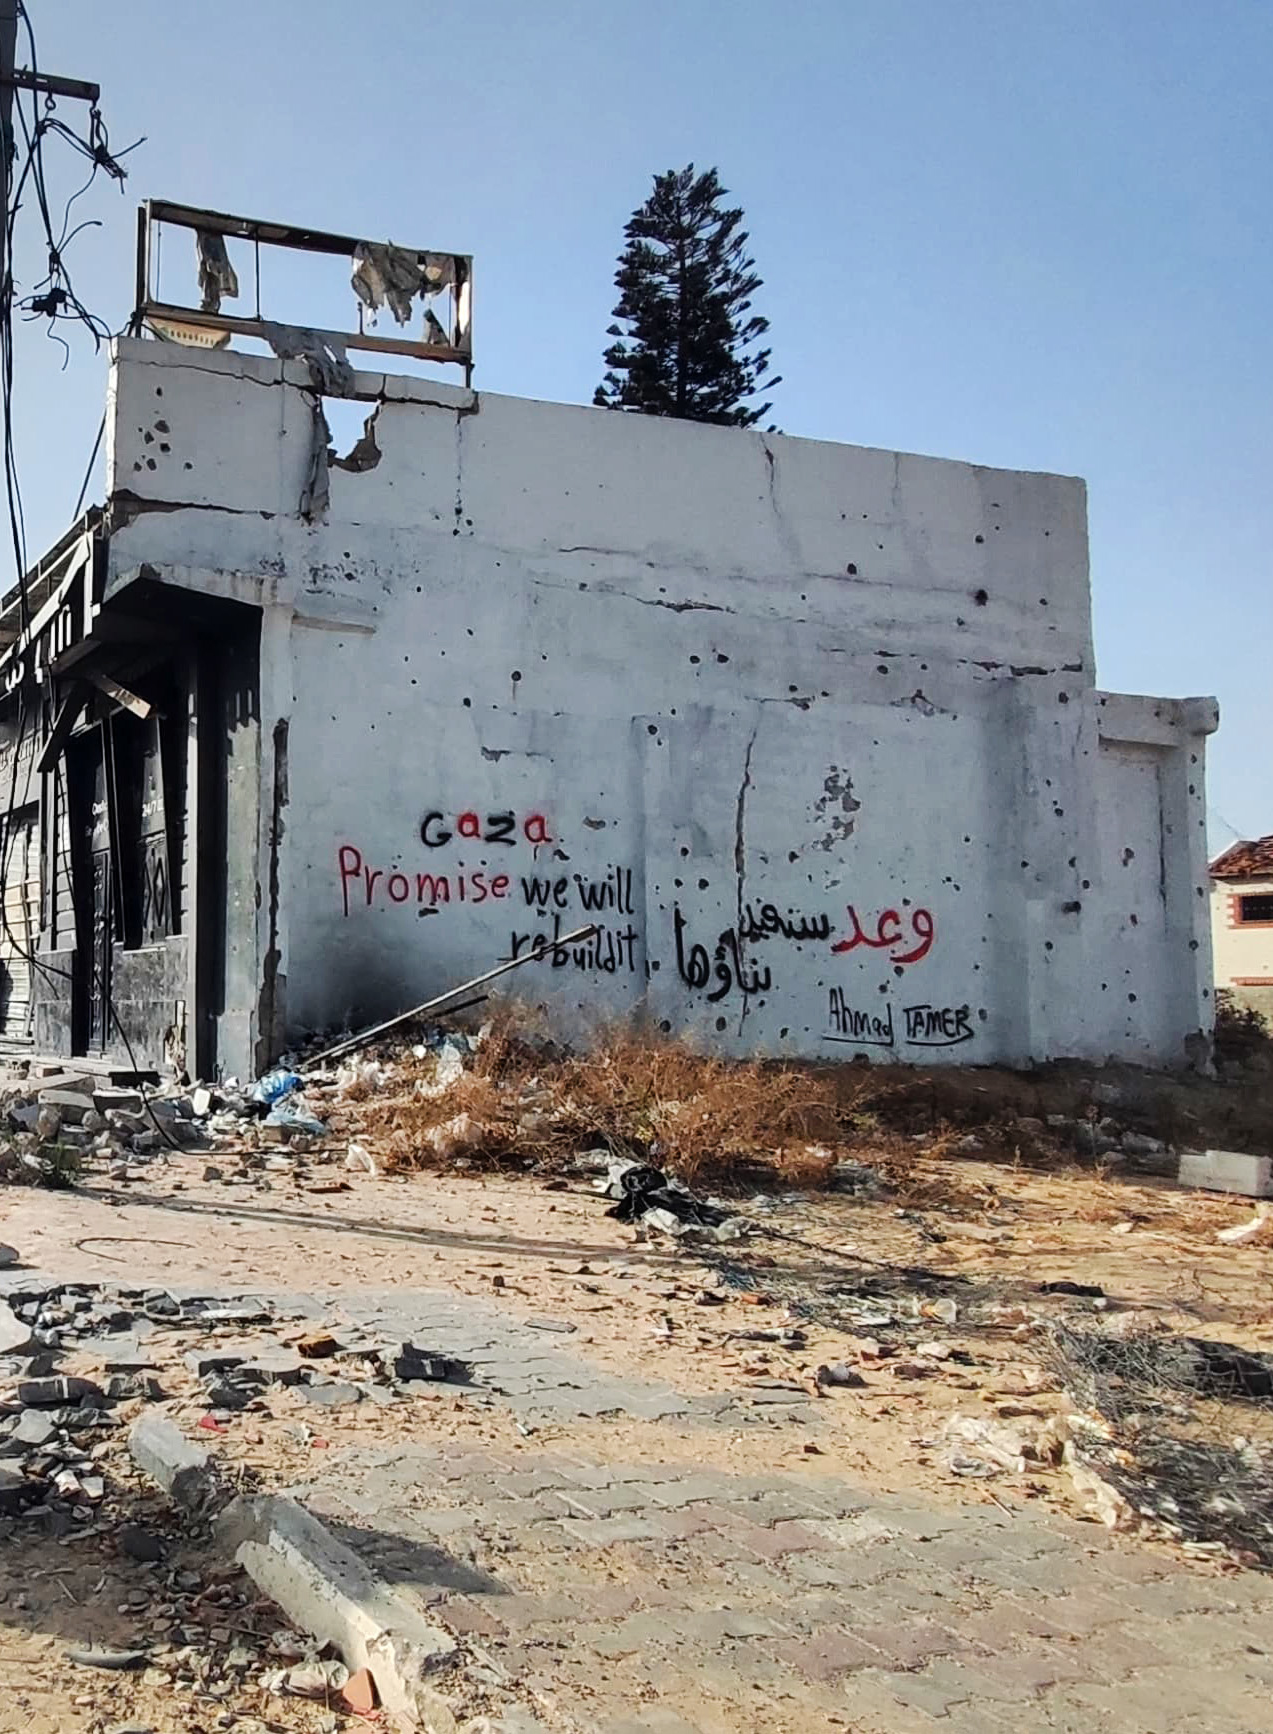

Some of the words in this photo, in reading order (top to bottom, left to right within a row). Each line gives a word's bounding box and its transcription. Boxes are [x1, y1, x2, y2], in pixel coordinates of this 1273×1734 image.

[420, 812, 553, 847] Gaza
[338, 845, 509, 917] Promise
[521, 877, 568, 908] we
[577, 866, 634, 914] will
[831, 904, 934, 963] وعد
[828, 986, 894, 1042] Ahmad
[902, 1004, 974, 1041] TAMER
